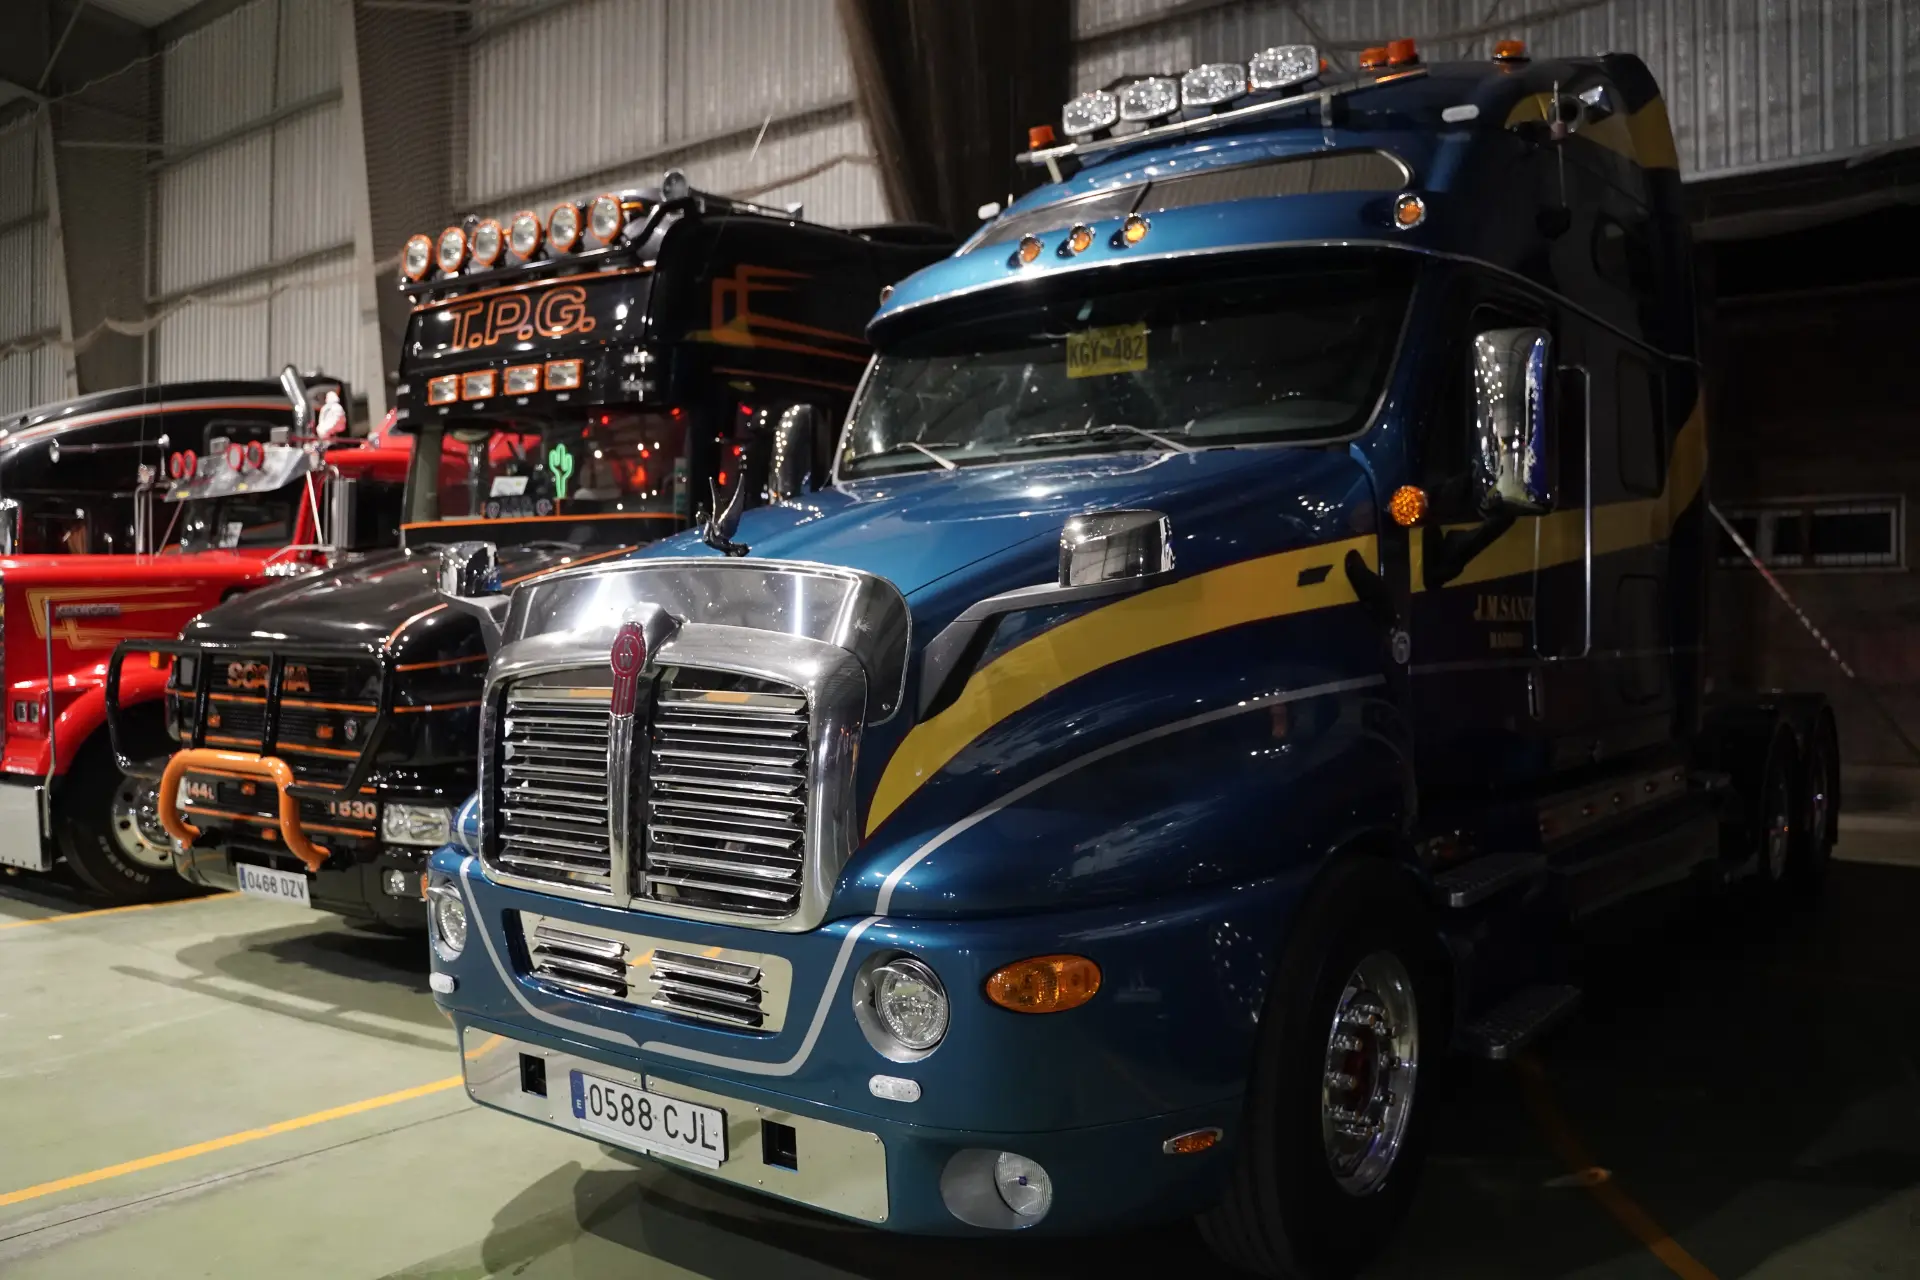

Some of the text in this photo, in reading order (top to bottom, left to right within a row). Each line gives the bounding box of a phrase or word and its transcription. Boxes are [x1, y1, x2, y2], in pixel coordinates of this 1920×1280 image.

[1069, 335, 1143, 368] KGY 482
[227, 661, 311, 692] SCAIA
[247, 871, 278, 894] 0468
[589, 1084, 717, 1151] 0588 CJL
